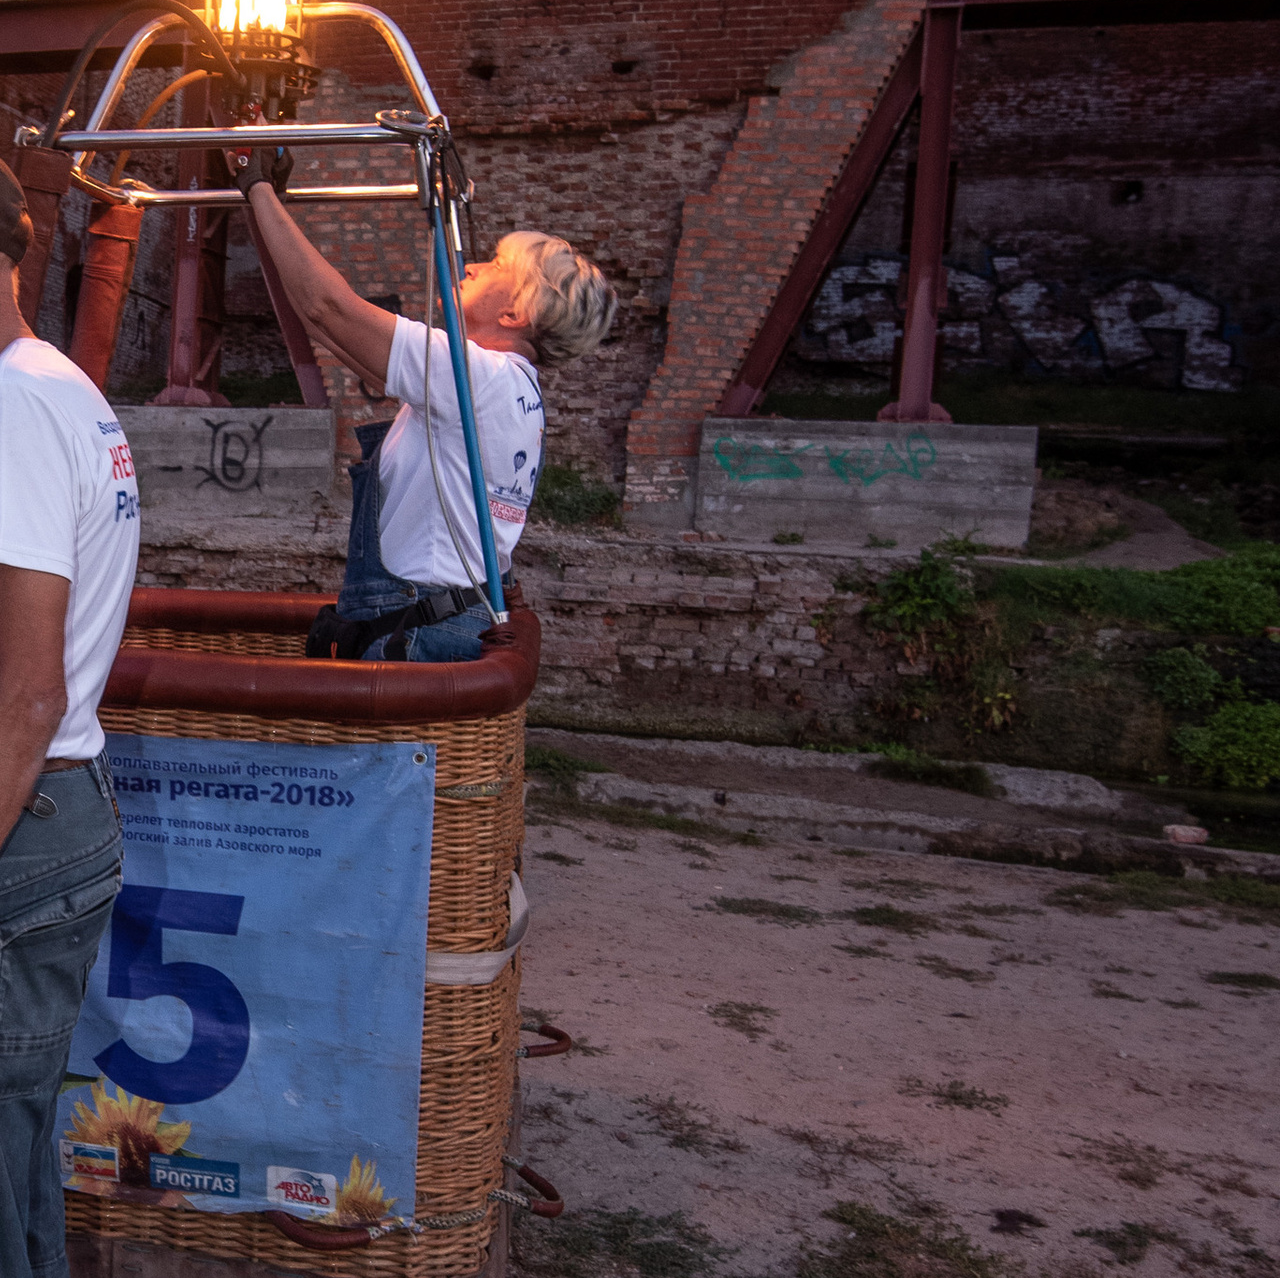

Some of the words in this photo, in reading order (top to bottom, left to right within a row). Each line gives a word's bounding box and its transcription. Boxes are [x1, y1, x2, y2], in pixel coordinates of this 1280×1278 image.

[246, 761, 339, 781] фестиваль
[169, 779, 356, 808] регата-2018»
[166, 818, 231, 833] тепловых
[234, 823, 310, 839] аэростатов
[173, 835, 212, 848] залив
[215, 837, 284, 855] Азовского
[287, 845, 322, 860] моря
[92, 883, 250, 1105] 5
[155, 1168, 235, 1193] РОСТГАЗ
[274, 1180, 311, 1194] АВТО
[285, 1190, 331, 1206] РАДИО
